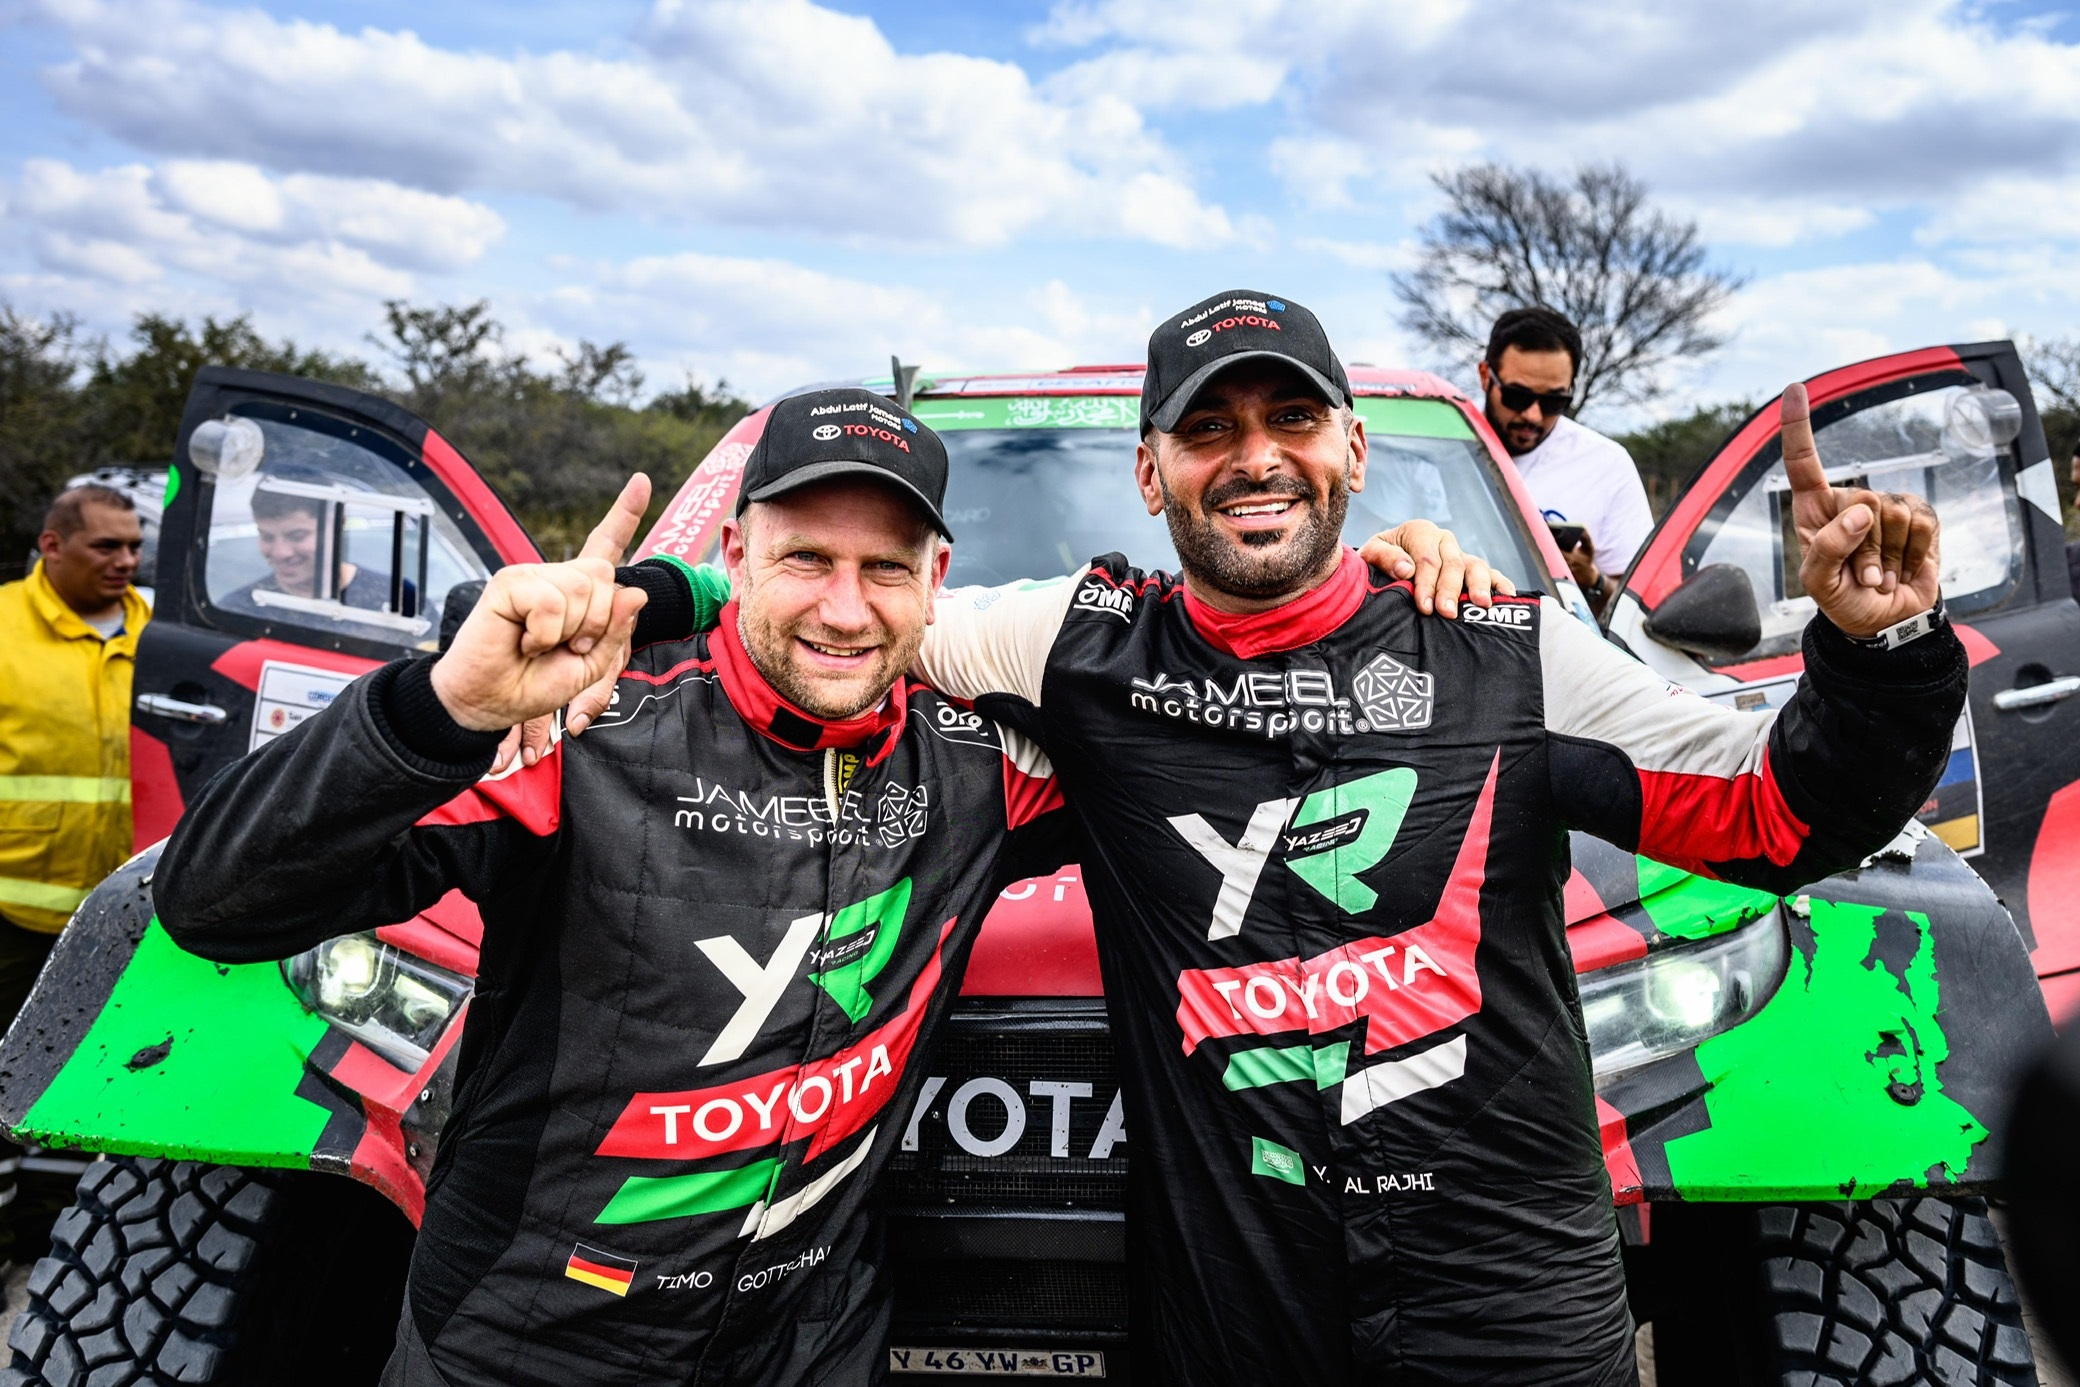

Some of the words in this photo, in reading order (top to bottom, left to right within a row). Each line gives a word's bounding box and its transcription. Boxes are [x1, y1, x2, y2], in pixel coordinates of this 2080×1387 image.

[1181, 310, 1209, 329] Abdul
[1208, 299, 1232, 316] Latif
[1212, 315, 1281, 332] TOYOTA
[810, 404, 842, 417] Abdul
[843, 402, 869, 412] Latif
[844, 424, 911, 454] TOYOTA
[650, 474, 722, 555] AMEEL
[1078, 587, 1134, 614] OMP
[1462, 605, 1531, 625] OMP
[1132, 670, 1350, 706] JAMEEL
[1131, 691, 1355, 739] motorsport
[1212, 943, 1449, 1021] TOYOTA
[649, 1043, 893, 1145] TOYOTA
[1312, 1165, 1331, 1184] Y.
[1344, 1176, 1371, 1194] AL
[1376, 1172, 1436, 1194] RAJHI
[656, 1271, 714, 1291] TIMO
[924, 1351, 966, 1371] 46
[975, 1352, 1018, 1372] YW
[1051, 1353, 1096, 1374] GP
